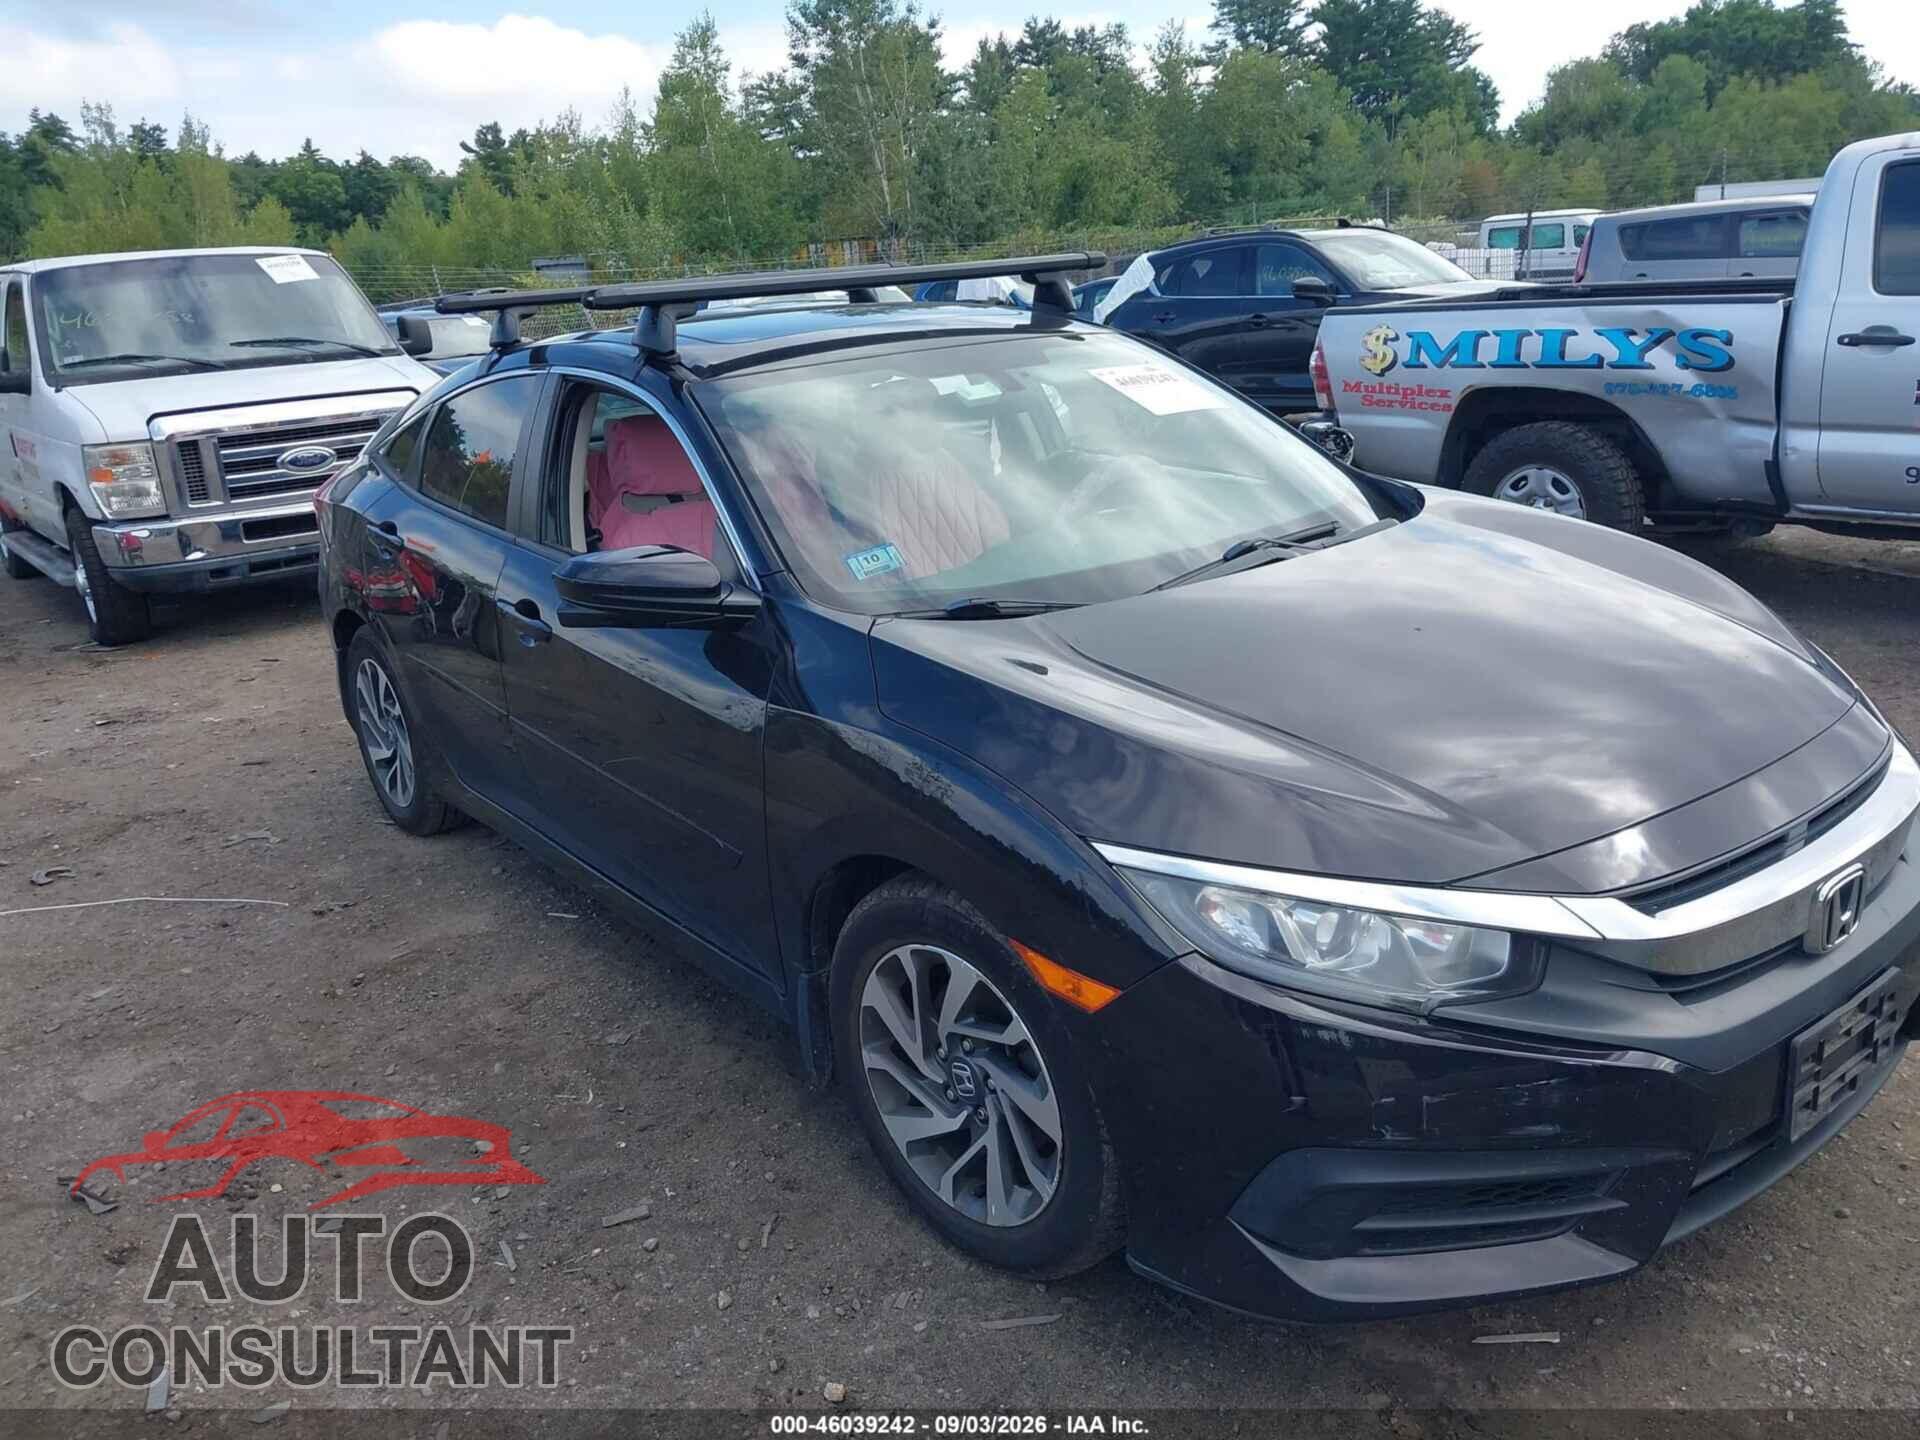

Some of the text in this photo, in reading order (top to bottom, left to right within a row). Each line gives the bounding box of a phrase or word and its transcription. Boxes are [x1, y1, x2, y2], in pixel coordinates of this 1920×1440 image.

[1342, 380, 1453, 400] Multiplex
[1361, 395, 1454, 413] Services
[863, 554, 880, 564] 10
